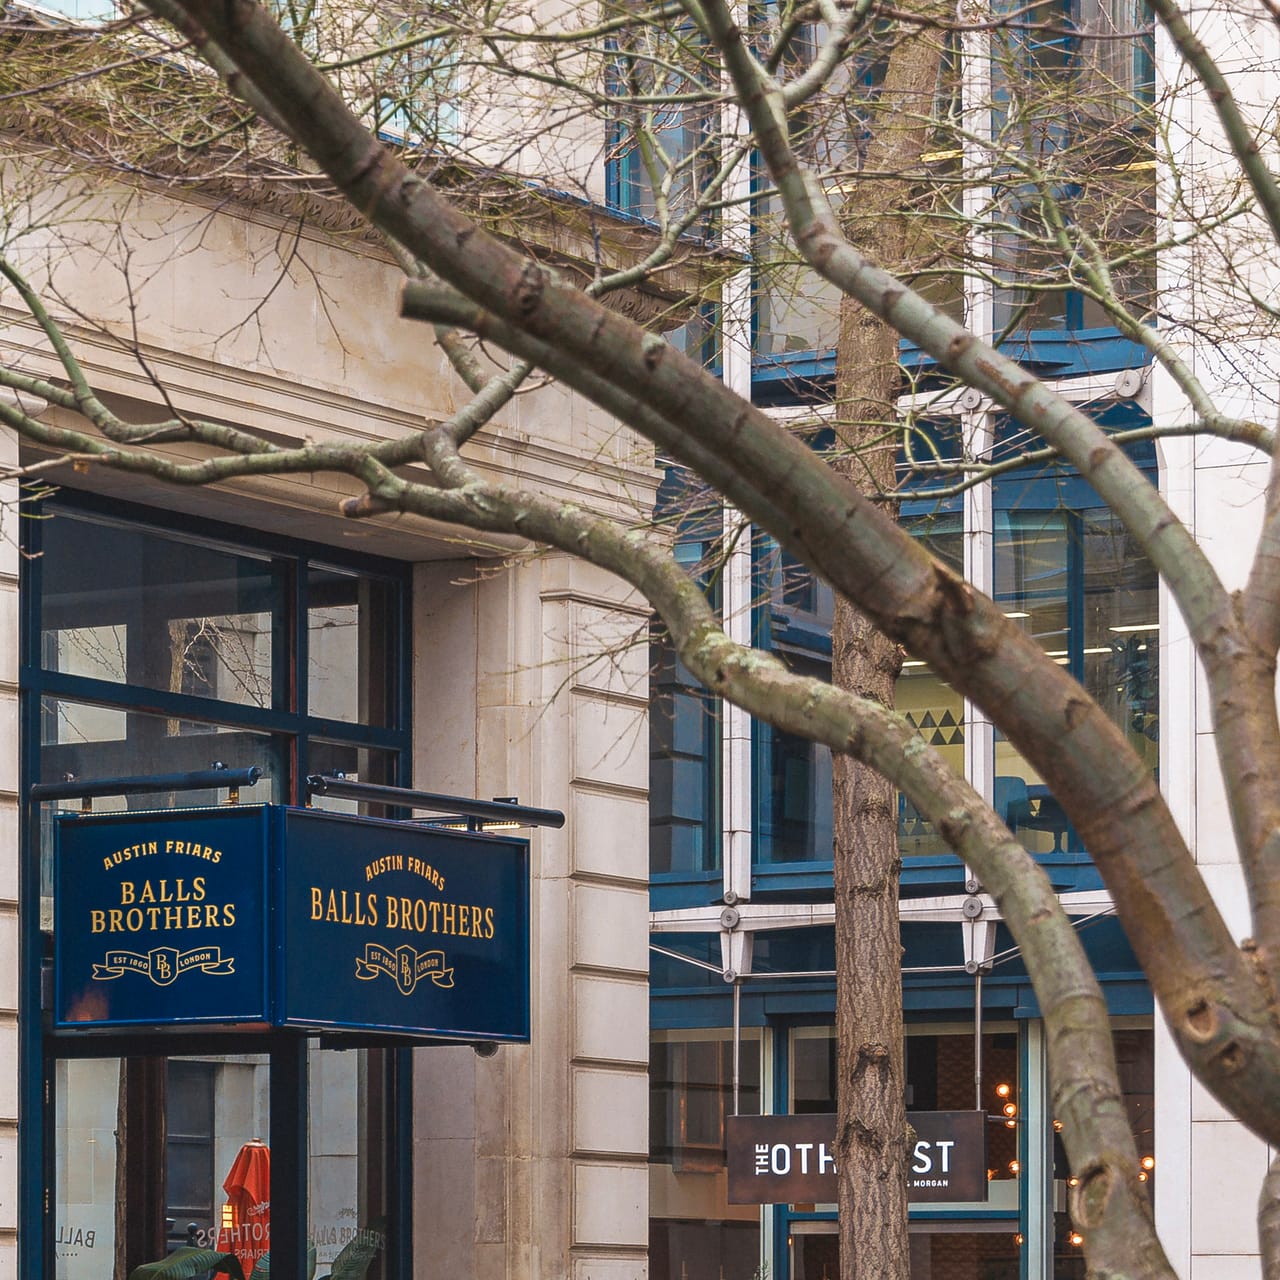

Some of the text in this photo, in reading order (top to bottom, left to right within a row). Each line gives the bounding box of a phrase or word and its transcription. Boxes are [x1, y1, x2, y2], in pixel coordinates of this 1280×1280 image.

[104, 841, 222, 870] AUSTIN FRIARS
[365, 855, 446, 891] AUSTIN FRIARS
[121, 877, 206, 904] BALLS
[91, 904, 236, 933] BROTHERS
[311, 888, 495, 939] BALLS BROTHERS
[130, 958, 148, 969] 1860
[180, 953, 210, 967] LONDON
[370, 952, 381, 960] EST
[417, 959, 439, 972] LONDON
[755, 1141, 955, 1175] THE OTHST
